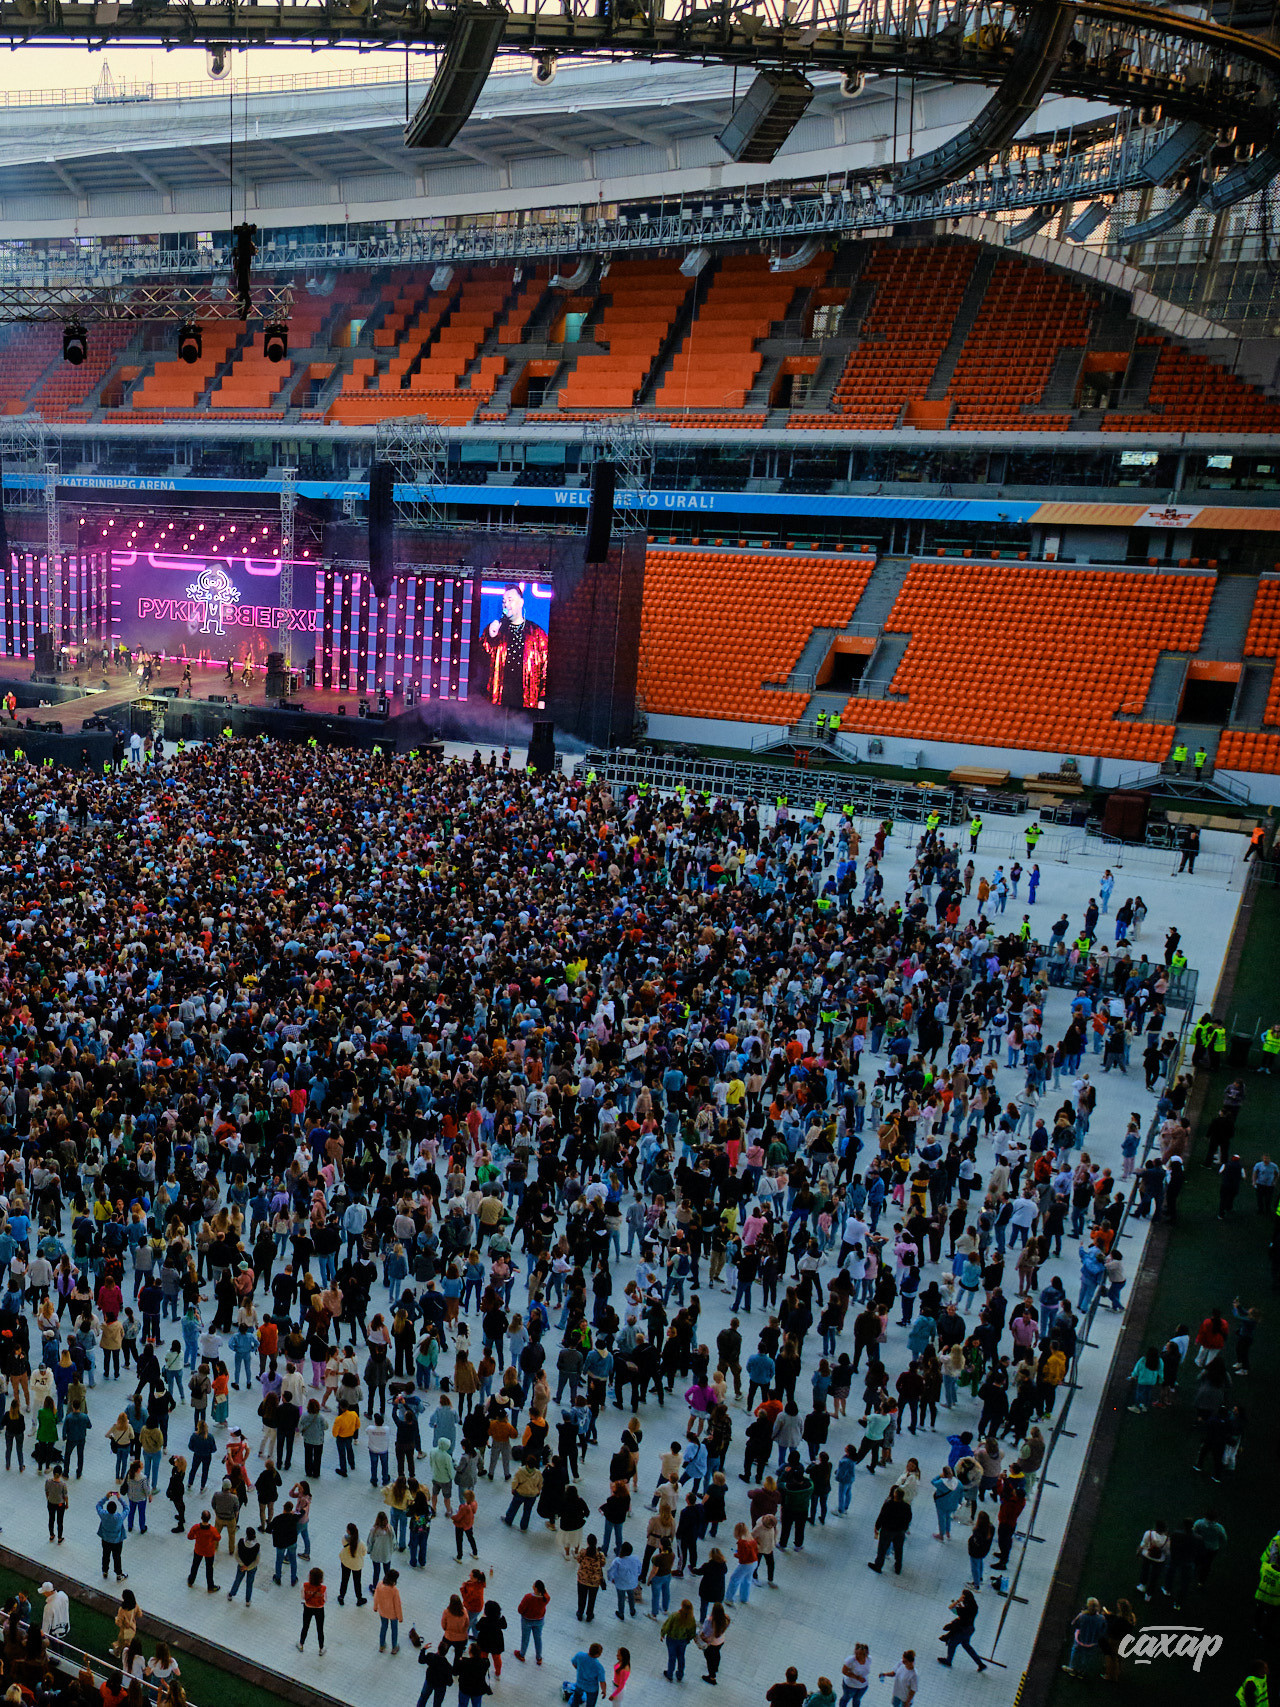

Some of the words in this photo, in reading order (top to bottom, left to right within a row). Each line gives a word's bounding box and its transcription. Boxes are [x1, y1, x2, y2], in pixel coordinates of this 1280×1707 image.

[139, 480, 176, 491] ARENA
[554, 491, 632, 506] WELCME
[638, 494, 658, 507] TO
[664, 495, 715, 509] URAL!
[138, 597, 206, 623] РУКИ
